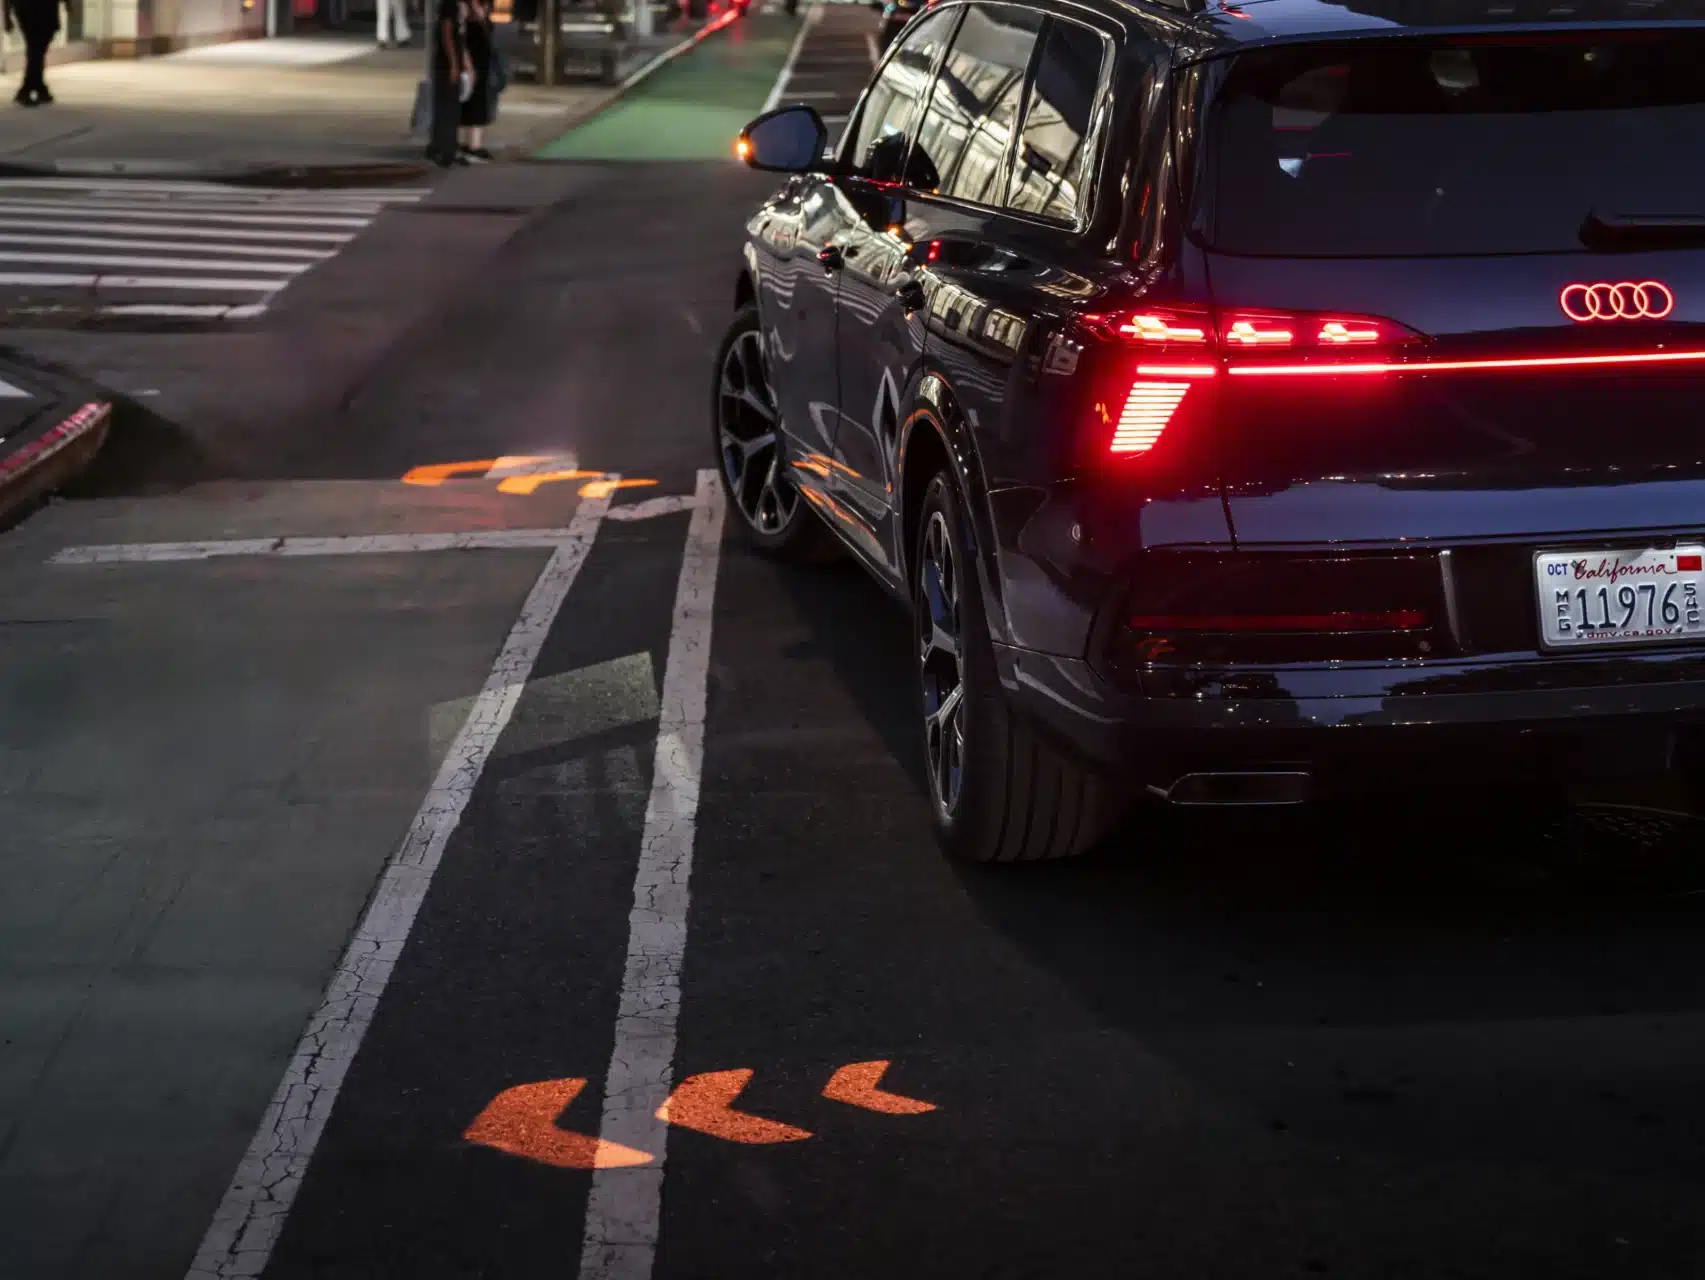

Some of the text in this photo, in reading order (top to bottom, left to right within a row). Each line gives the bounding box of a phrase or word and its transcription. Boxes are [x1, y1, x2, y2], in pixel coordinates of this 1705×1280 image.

[1547, 558, 1677, 584] OCT California
[1556, 589, 1572, 632] MFG
[1576, 583, 1680, 629] 11976
[1586, 627, 1672, 639] dmv.ca.gov
